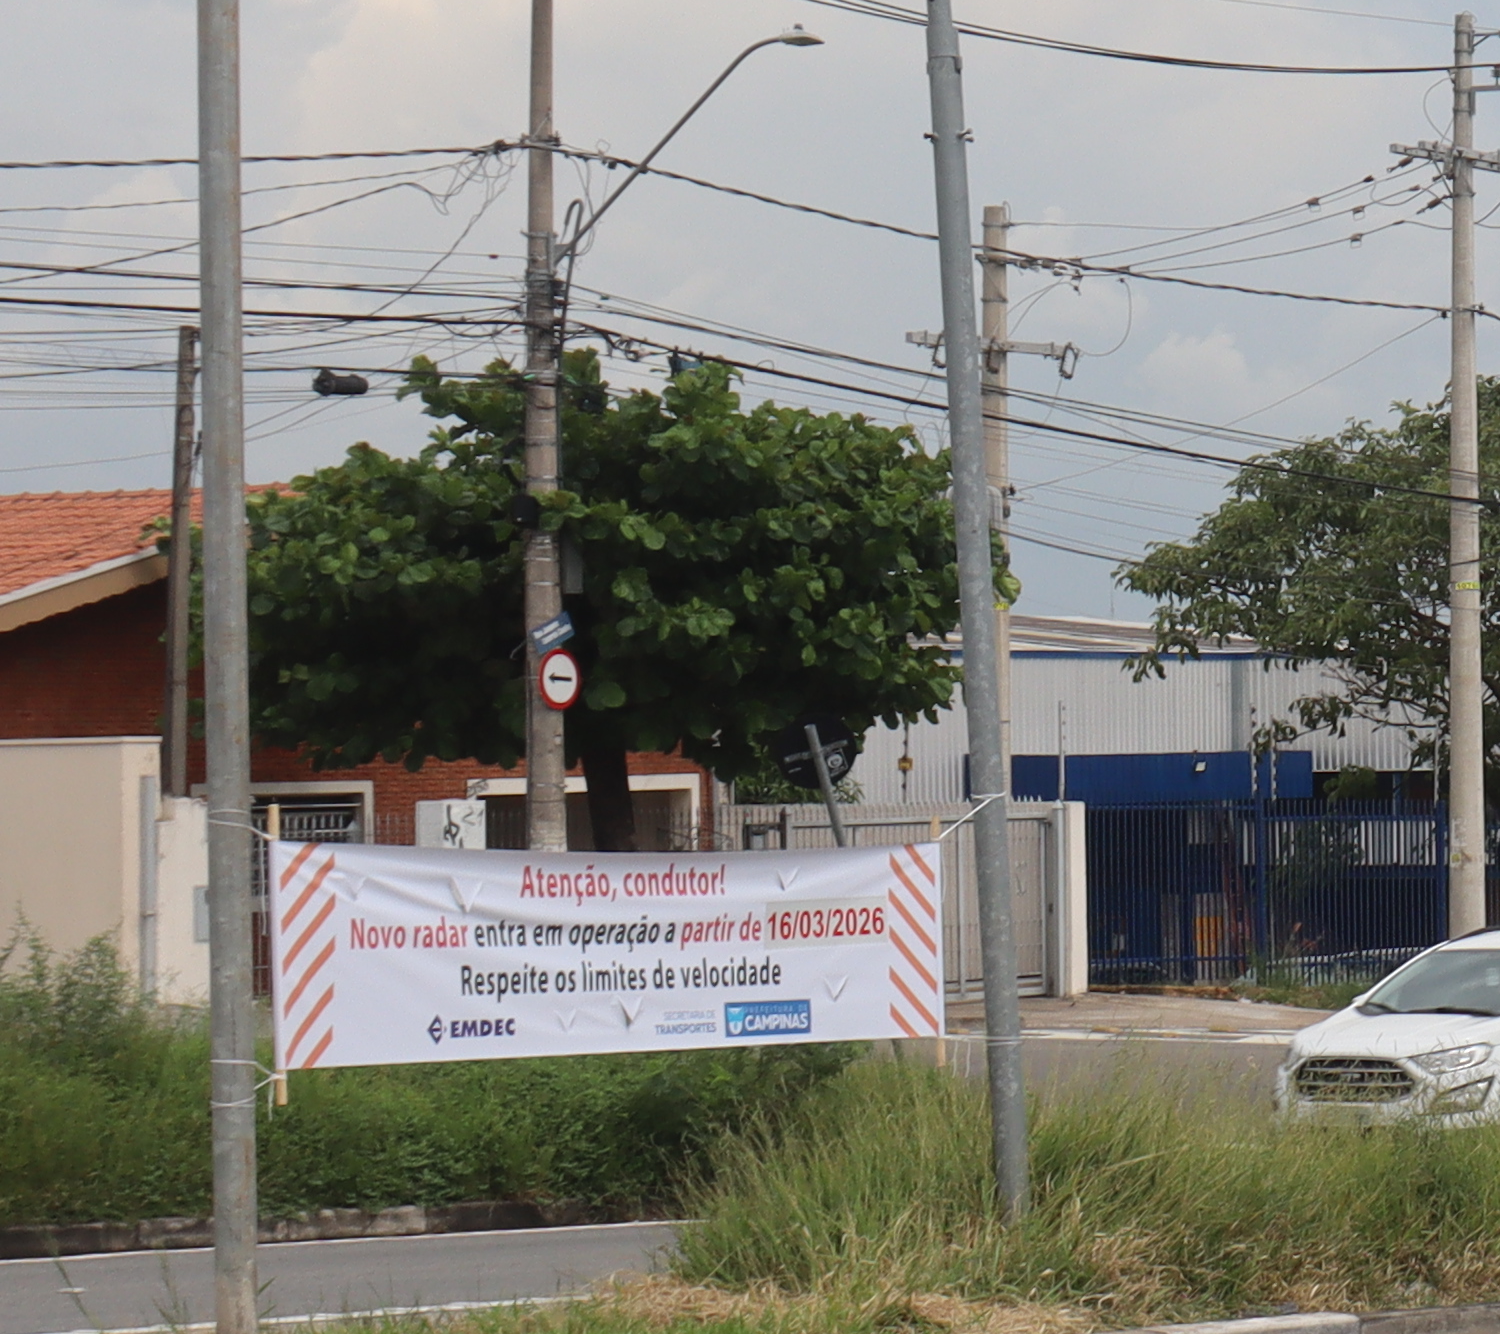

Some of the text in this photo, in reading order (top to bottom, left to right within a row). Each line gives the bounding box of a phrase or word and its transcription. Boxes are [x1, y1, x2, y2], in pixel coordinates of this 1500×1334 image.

[520, 863, 726, 906] Atenção, condutor!
[350, 906, 885, 954] Novo radar entra em operação a partir de 16/03/2026
[461, 955, 782, 1004] Respeite os limites de velocidade
[663, 1010, 706, 1022] SECRETARIA
[744, 1012, 809, 1032] CAMPINAS
[450, 1018, 516, 1039] EMDEC
[655, 1021, 717, 1035] TRANSPORTES
